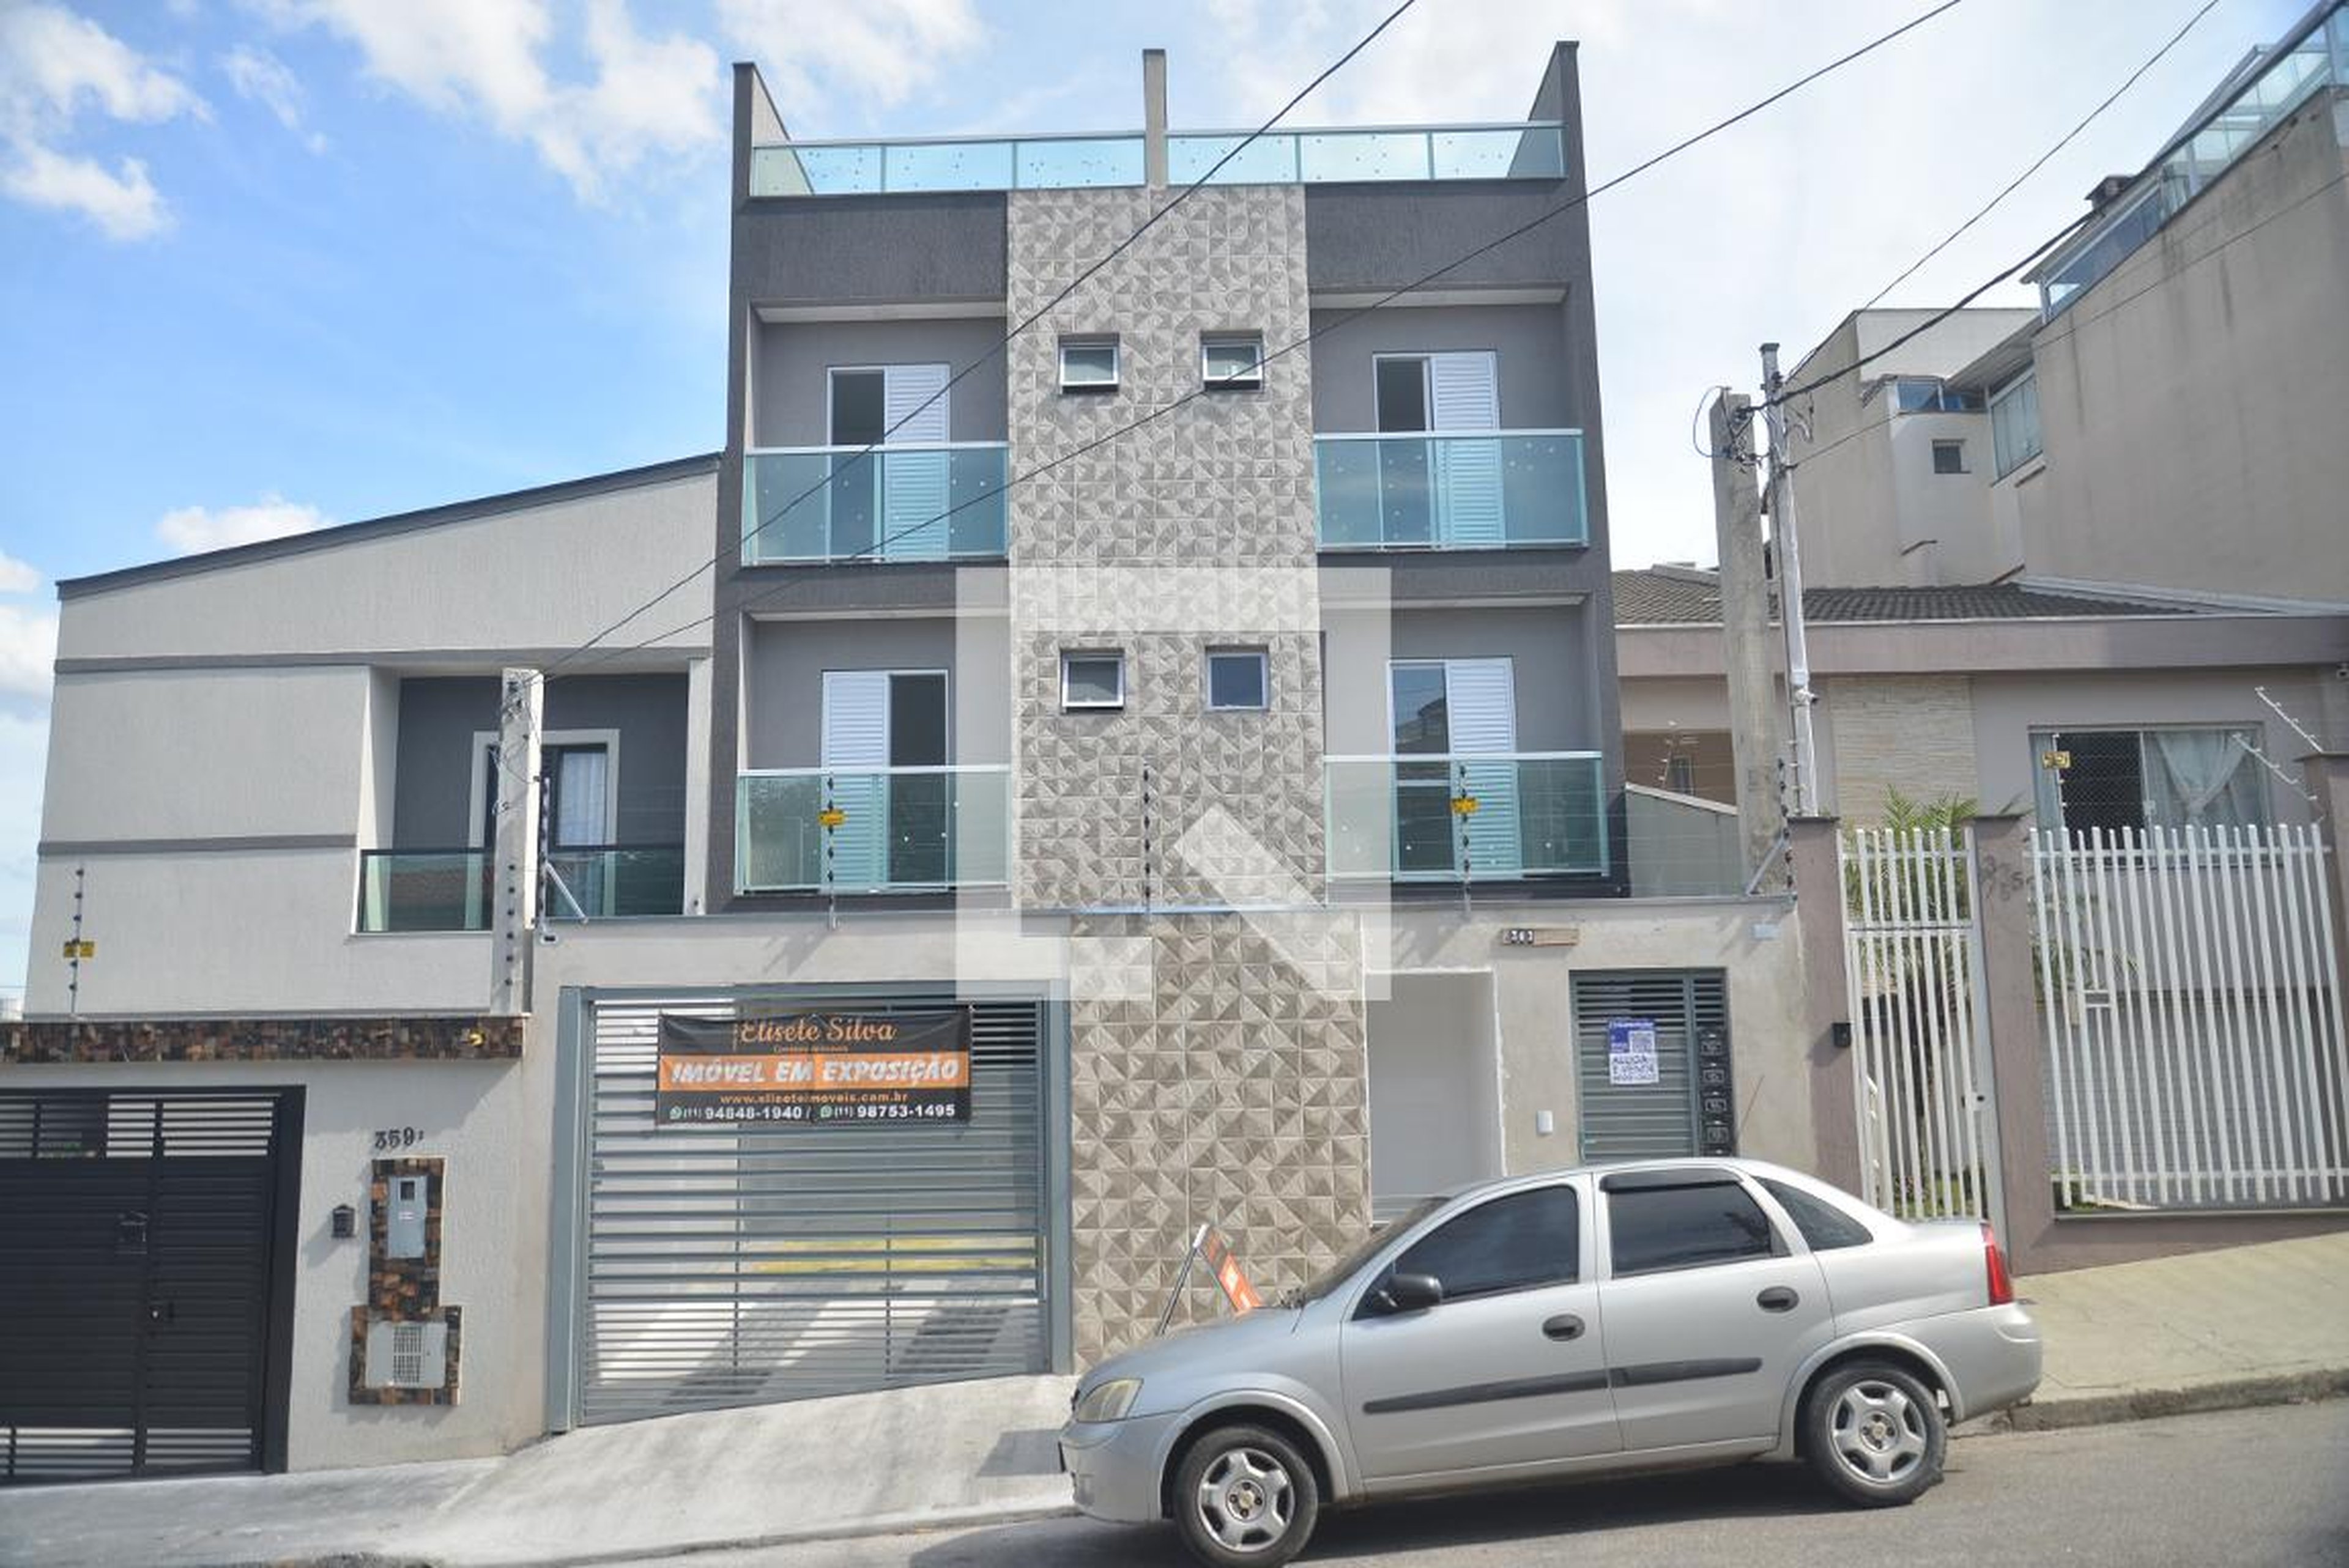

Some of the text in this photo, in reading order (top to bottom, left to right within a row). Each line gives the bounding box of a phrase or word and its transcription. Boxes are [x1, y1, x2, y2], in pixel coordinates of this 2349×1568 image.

[741, 1018, 897, 1042] Elisete Silva
[672, 1054, 959, 1087] IMÓVEL EM EXPOSIÇÃO
[704, 1106, 801, 1119] 94848-1940
[857, 1104, 956, 1118] 98753-1495
